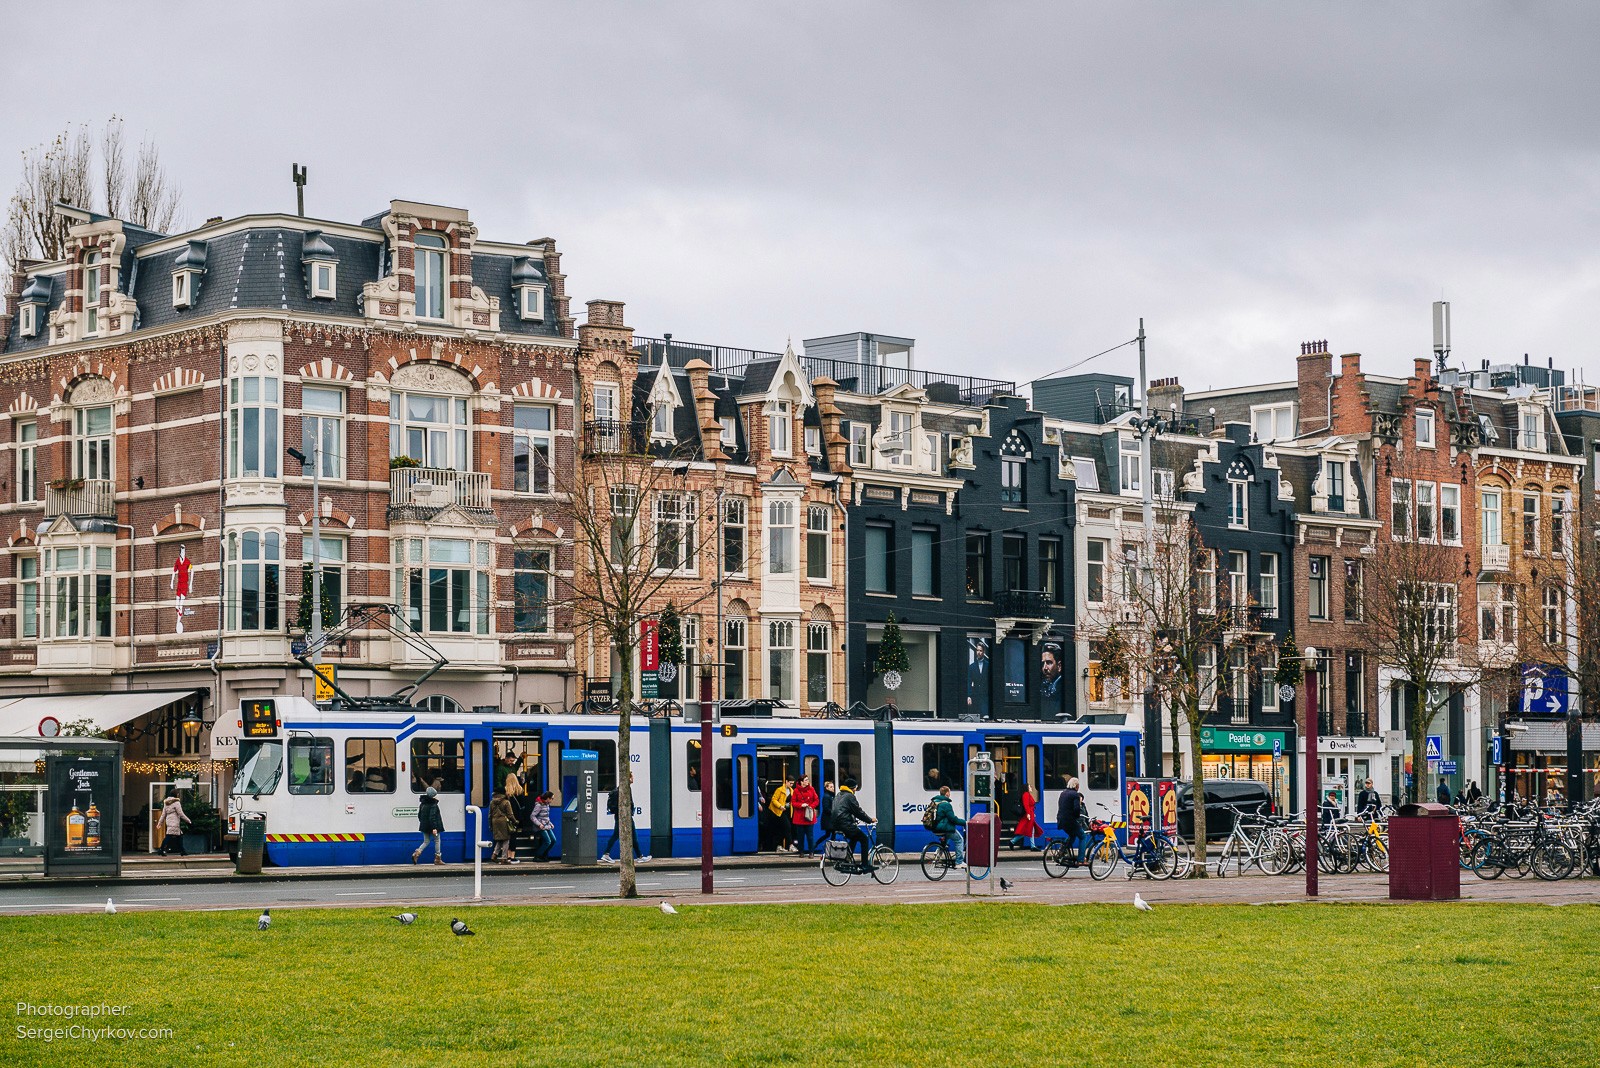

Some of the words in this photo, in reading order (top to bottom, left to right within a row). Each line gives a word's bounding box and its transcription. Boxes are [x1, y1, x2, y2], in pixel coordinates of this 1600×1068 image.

[647, 654, 653, 667] TE
[1523, 677, 1544, 712] P
[253, 704, 260, 718] 5
[725, 725, 731, 736] 5
[1229, 733, 1251, 743] Pearle
[1274, 740, 1280, 751] P
[1494, 739, 1500, 761] P
[629, 754, 641, 763] 02
[901, 755, 915, 763] 902
[69, 768, 99, 780] Gentleman
[77, 779, 91, 789] Jack
[917, 804, 928, 812] GV
